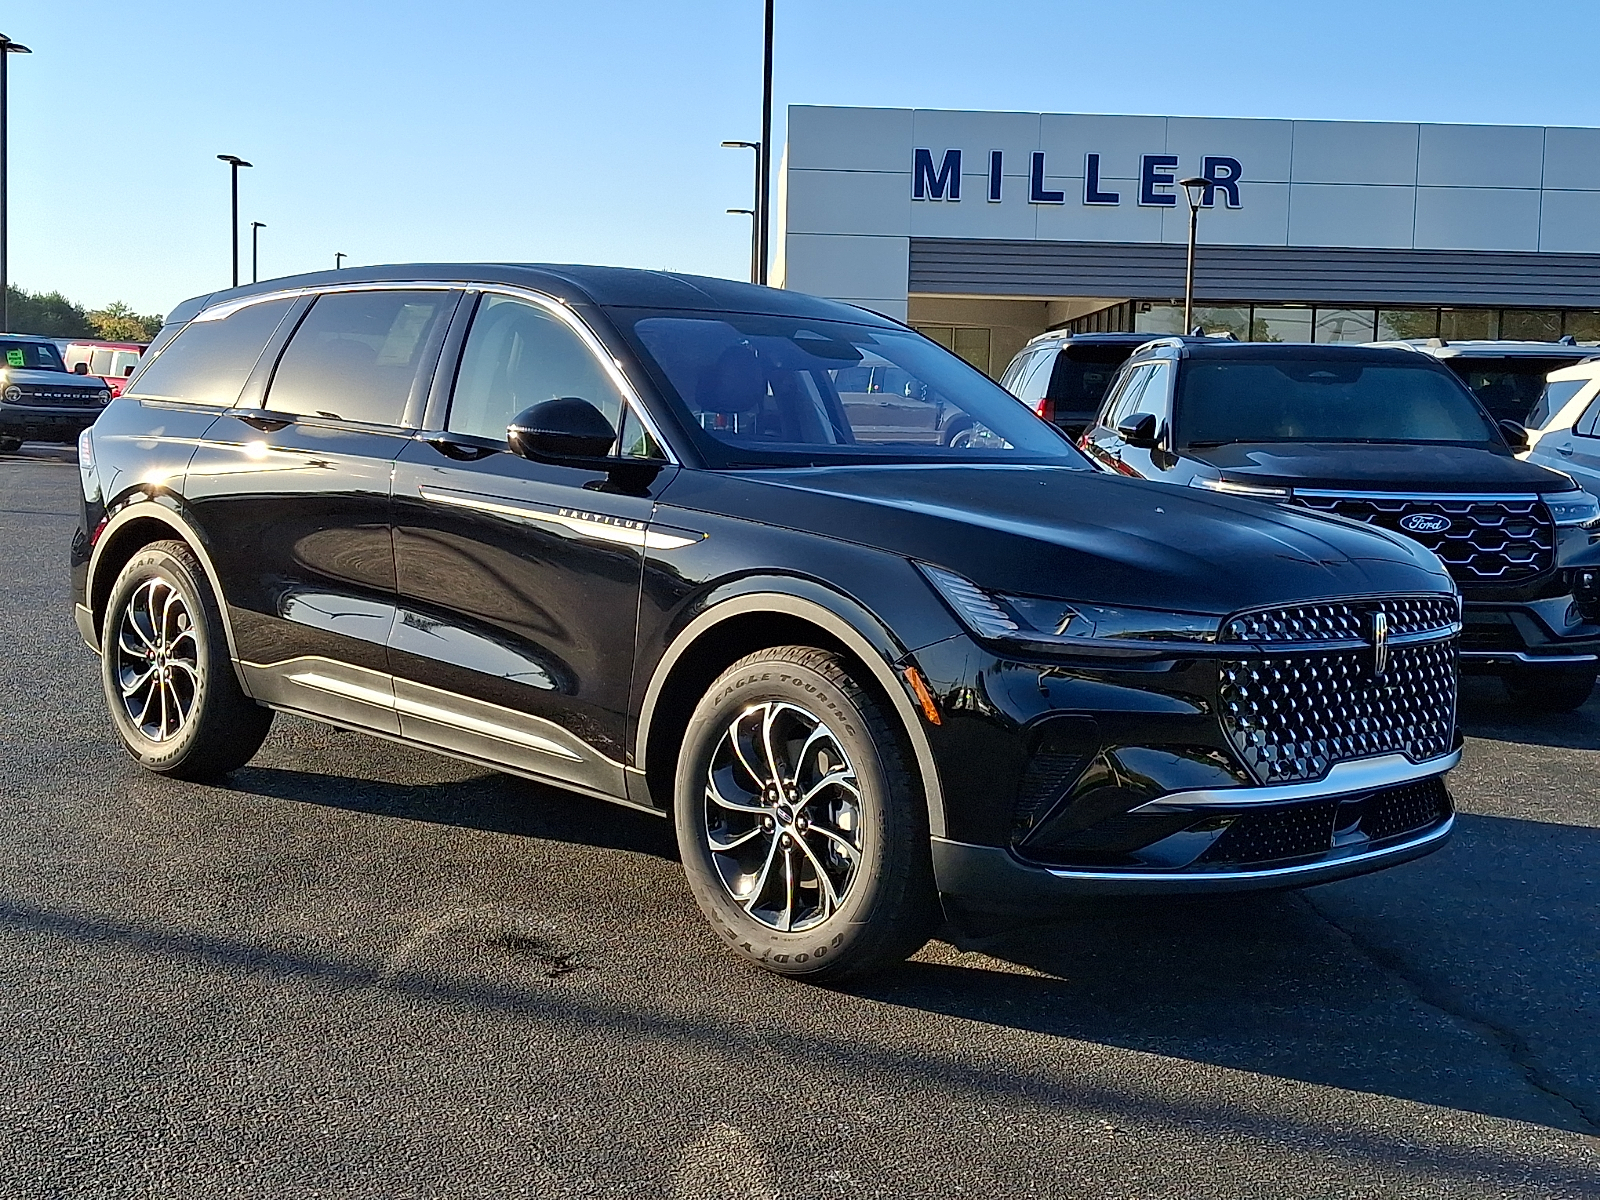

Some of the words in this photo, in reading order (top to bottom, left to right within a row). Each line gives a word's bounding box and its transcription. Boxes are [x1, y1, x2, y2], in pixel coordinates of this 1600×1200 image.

[911, 147, 1243, 208] MILLER
[558, 508, 644, 530] NAUTILUS
[1407, 515, 1444, 530] Ford
[714, 672, 771, 706] EAGLE
[780, 674, 856, 737] TOURING
